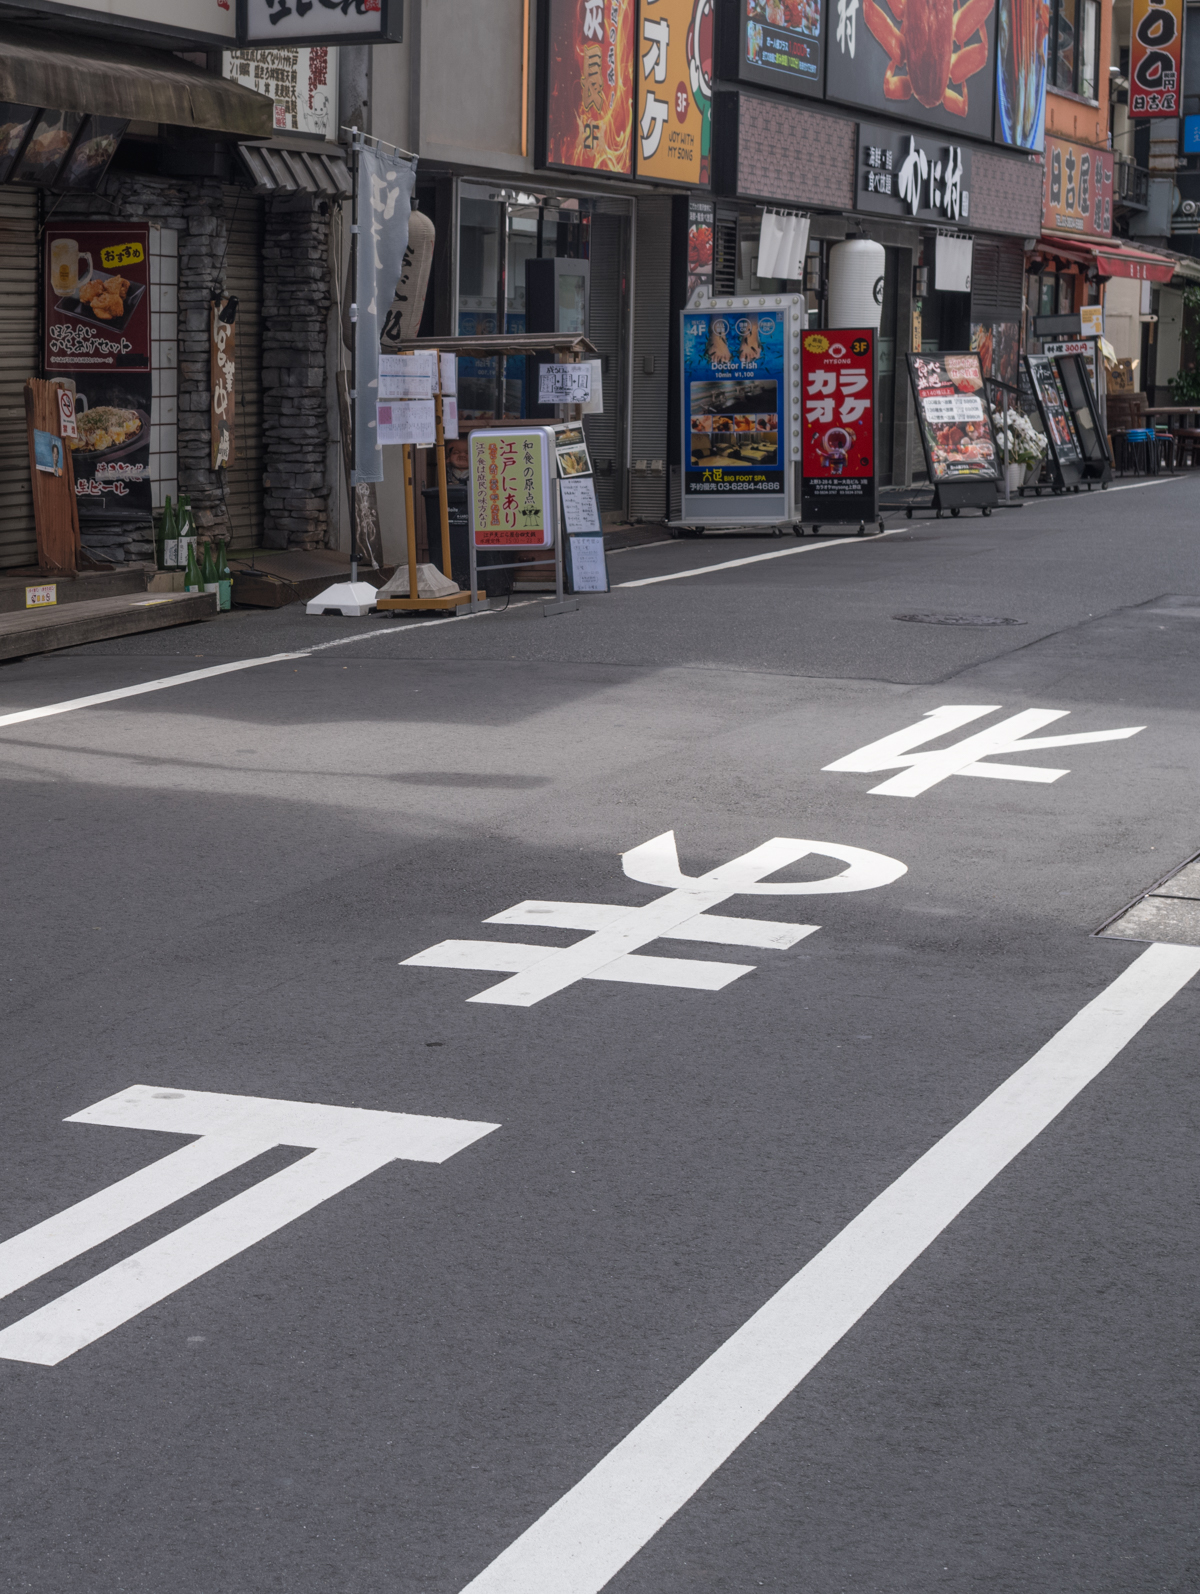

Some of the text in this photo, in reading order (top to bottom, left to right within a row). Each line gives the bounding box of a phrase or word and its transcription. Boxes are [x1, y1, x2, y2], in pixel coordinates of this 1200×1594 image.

[640, 0, 669, 161] オケ
[676, 92, 687, 113] 3F
[1133, 92, 1176, 112] 日吉屋
[583, 123, 599, 150] 2F
[668, 131, 694, 146] JOY WITH
[667, 146, 693, 161] MY SONG
[898, 134, 963, 221] かに村
[1050, 145, 1091, 217] 日吉屋
[104, 247, 142, 264] おすすめ
[49, 324, 97, 339] ほろよい
[690, 325, 706, 336] 4F
[49, 337, 133, 354] からあげセット
[853, 342, 867, 353] 3F
[1047, 345, 1063, 353] 料理
[711, 361, 758, 370] Doctor Fish
[806, 368, 869, 396] カラ
[805, 396, 871, 424] オケ
[523, 440, 536, 505] 和食の原点
[702, 468, 723, 482] 大足
[476, 442, 487, 529] 江戸食は庶民の味方なり
[499, 439, 519, 528] 江戸にあり
[689, 482, 780, 491] 予約優先 03-6284-4686
